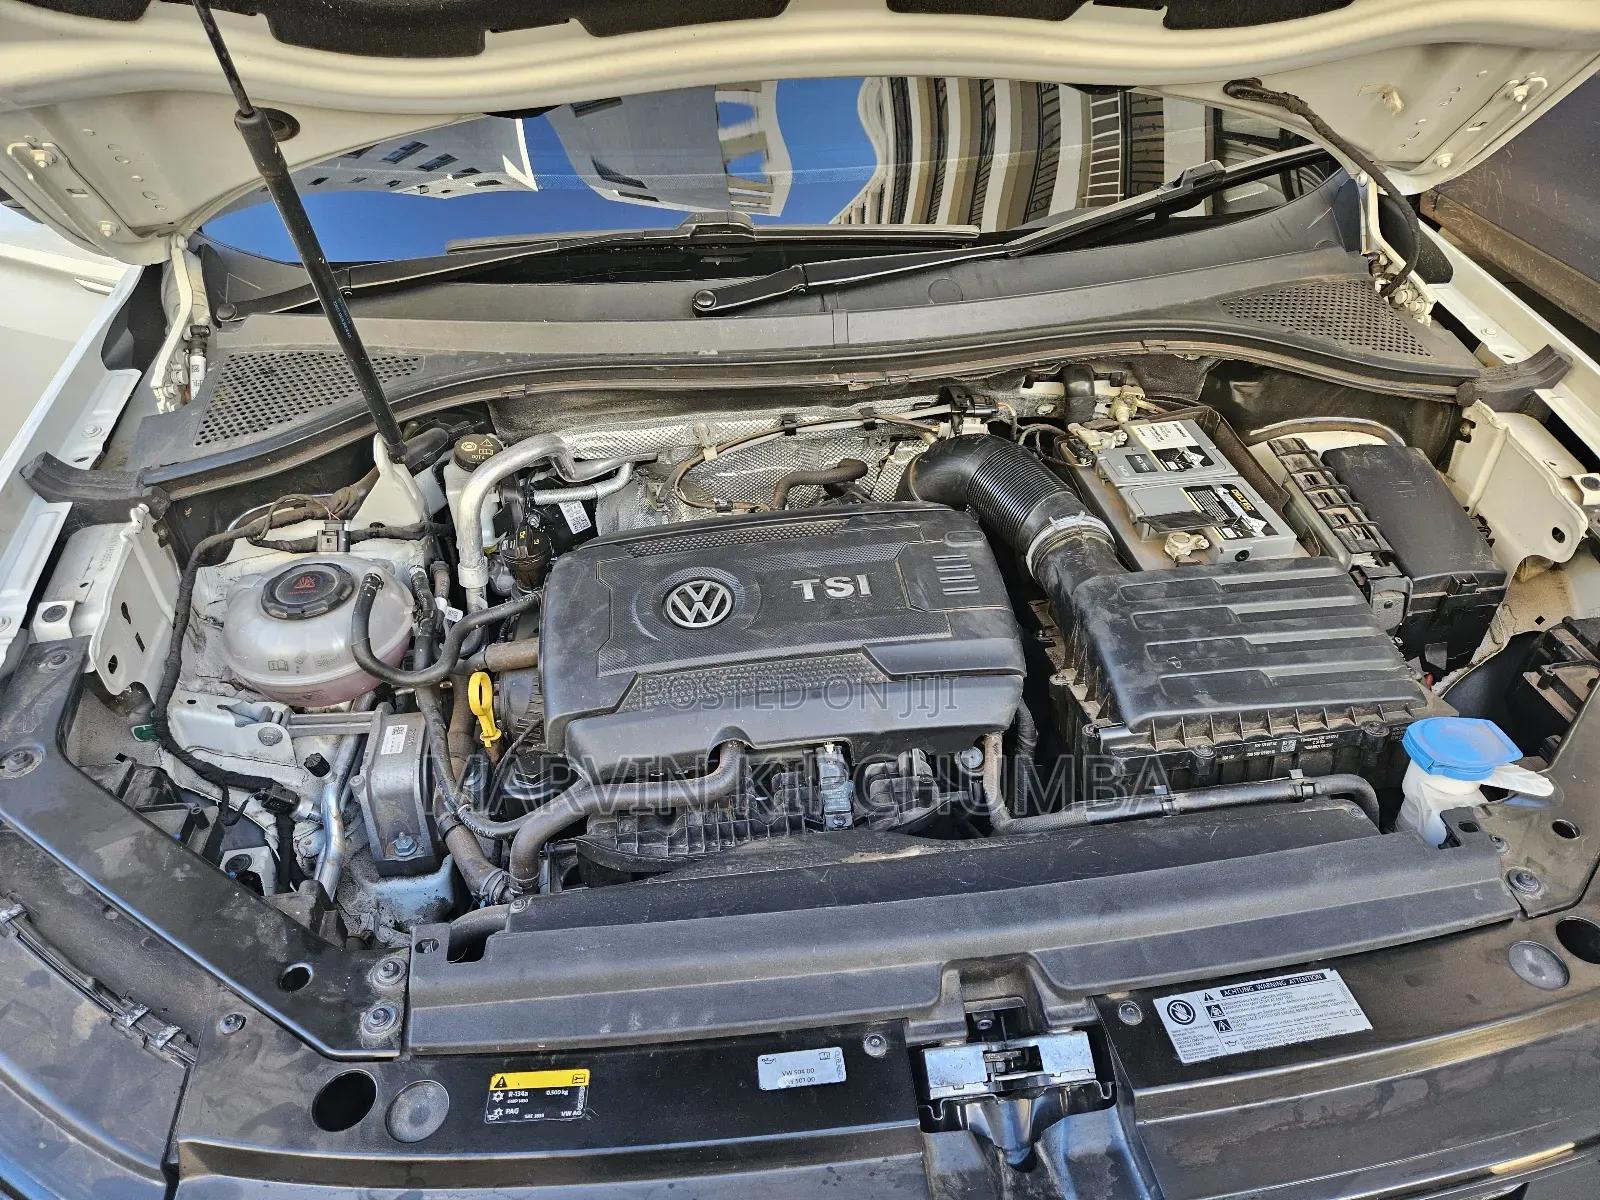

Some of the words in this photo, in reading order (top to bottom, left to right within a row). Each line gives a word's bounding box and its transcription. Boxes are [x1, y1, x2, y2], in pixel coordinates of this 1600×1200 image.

[1230, 488, 1255, 511] DELTEC
[791, 574, 873, 603] TSI
[1223, 985, 1255, 998] ACHTUNG
[1255, 979, 1287, 991] WARNING
[1289, 973, 1323, 986] ATTENTION
